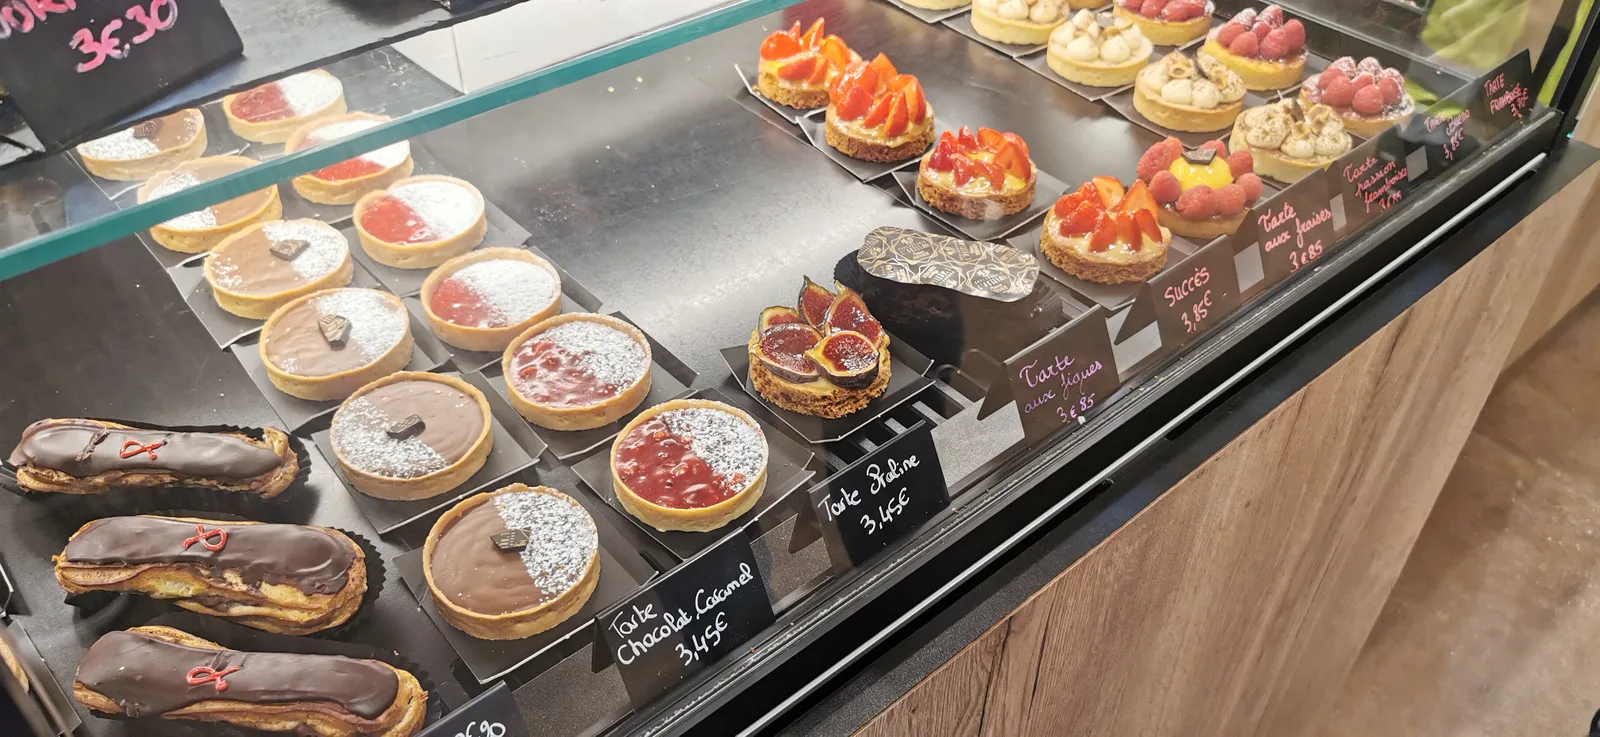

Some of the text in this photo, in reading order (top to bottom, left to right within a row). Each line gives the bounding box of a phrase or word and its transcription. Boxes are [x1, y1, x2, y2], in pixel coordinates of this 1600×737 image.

[1483, 72, 1505, 97] TARTE
[1342, 156, 1378, 183] Tarte
[1355, 160, 1396, 198] passion
[1257, 201, 1297, 233] Tarte
[1264, 207, 1332, 253] aux fraises
[1181, 289, 1213, 334] 3,85€
[1019, 355, 1075, 388] Tarte
[1024, 360, 1103, 414] aux figues
[817, 454, 921, 522] Tarte Praline
[859, 486, 910, 535] 3,45€
[607, 602, 658, 639] Tarte
[674, 610, 728, 667] 3,45€
